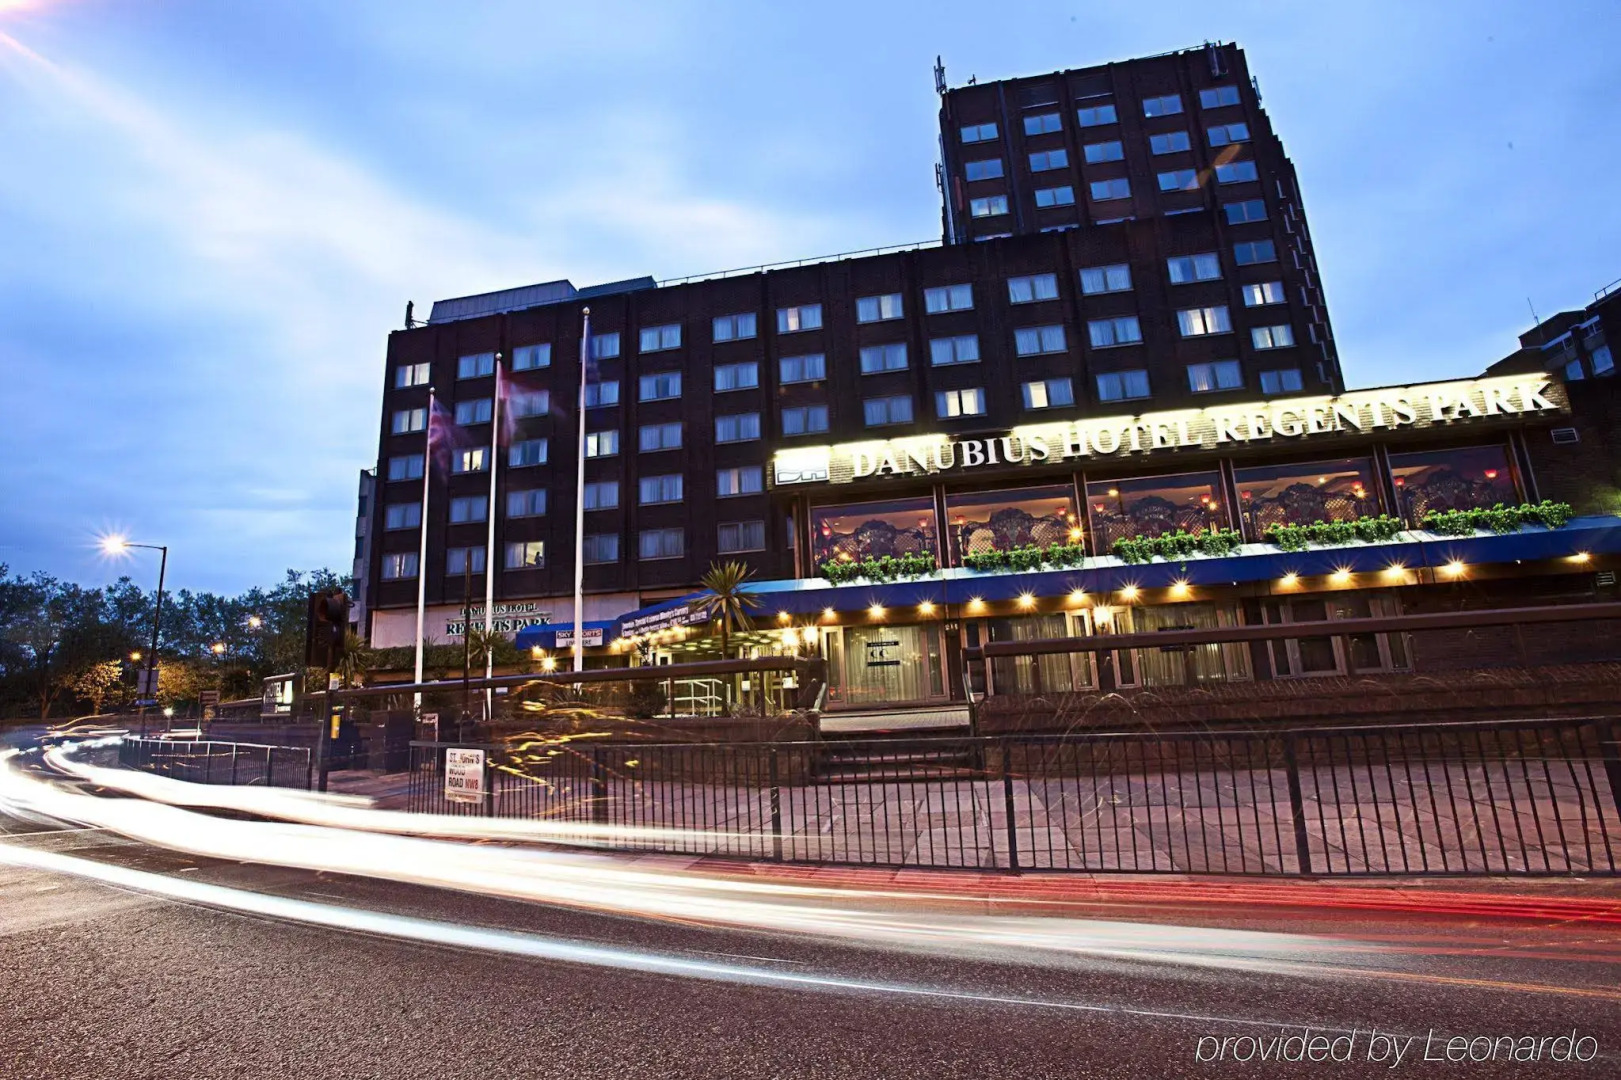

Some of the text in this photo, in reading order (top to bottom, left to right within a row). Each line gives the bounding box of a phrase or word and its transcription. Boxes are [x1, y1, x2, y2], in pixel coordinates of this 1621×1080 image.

[852, 381, 1560, 478] DANUBIUS HOTEL REGENTS PARK
[459, 602, 539, 617] DANUIUS HOTEL
[446, 618, 511, 636] REETS
[557, 629, 601, 639] SKY ORTS
[448, 777, 479, 790] ROAD NW8
